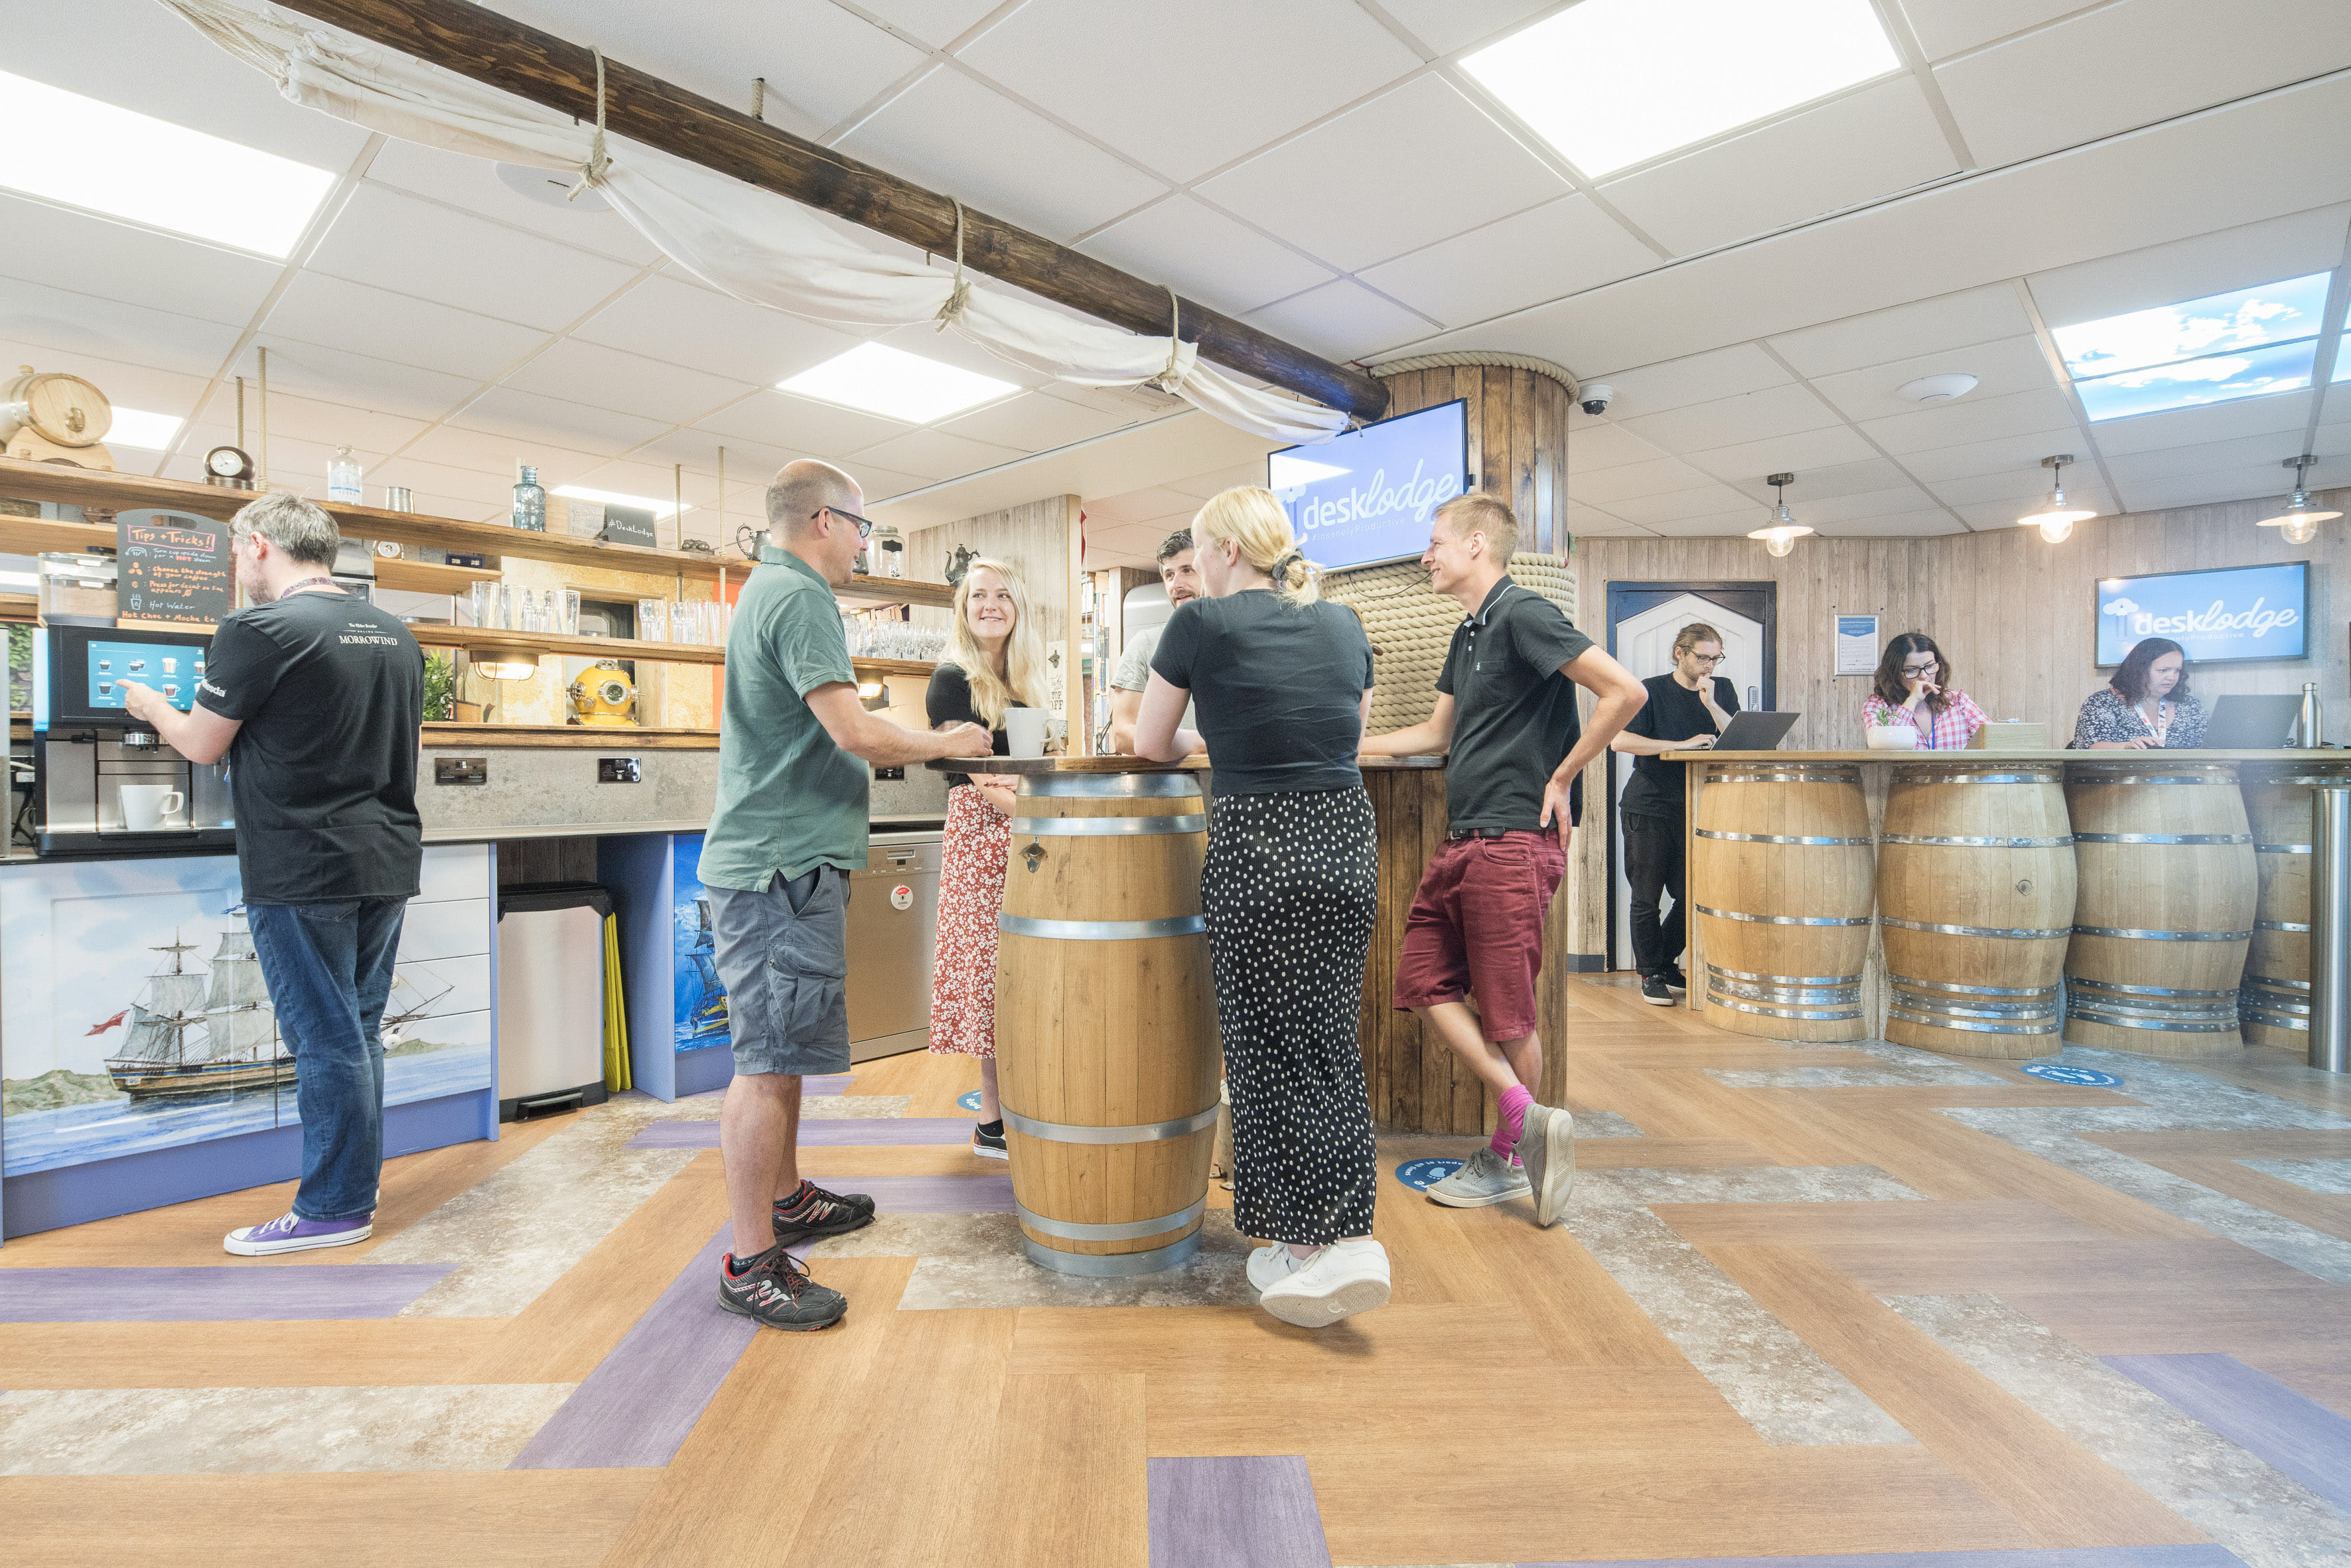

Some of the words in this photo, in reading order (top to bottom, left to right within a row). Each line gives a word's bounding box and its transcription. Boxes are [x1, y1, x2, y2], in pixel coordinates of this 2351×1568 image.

[132, 529, 155, 542] Tips
[608, 519, 654, 537] #DeskLodge
[1312, 517, 1407, 541] #InsanelyProductive
[149, 600, 164, 610] Hot
[2135, 597, 2299, 638] desklodge
[338, 636, 397, 646] MORROWIND
